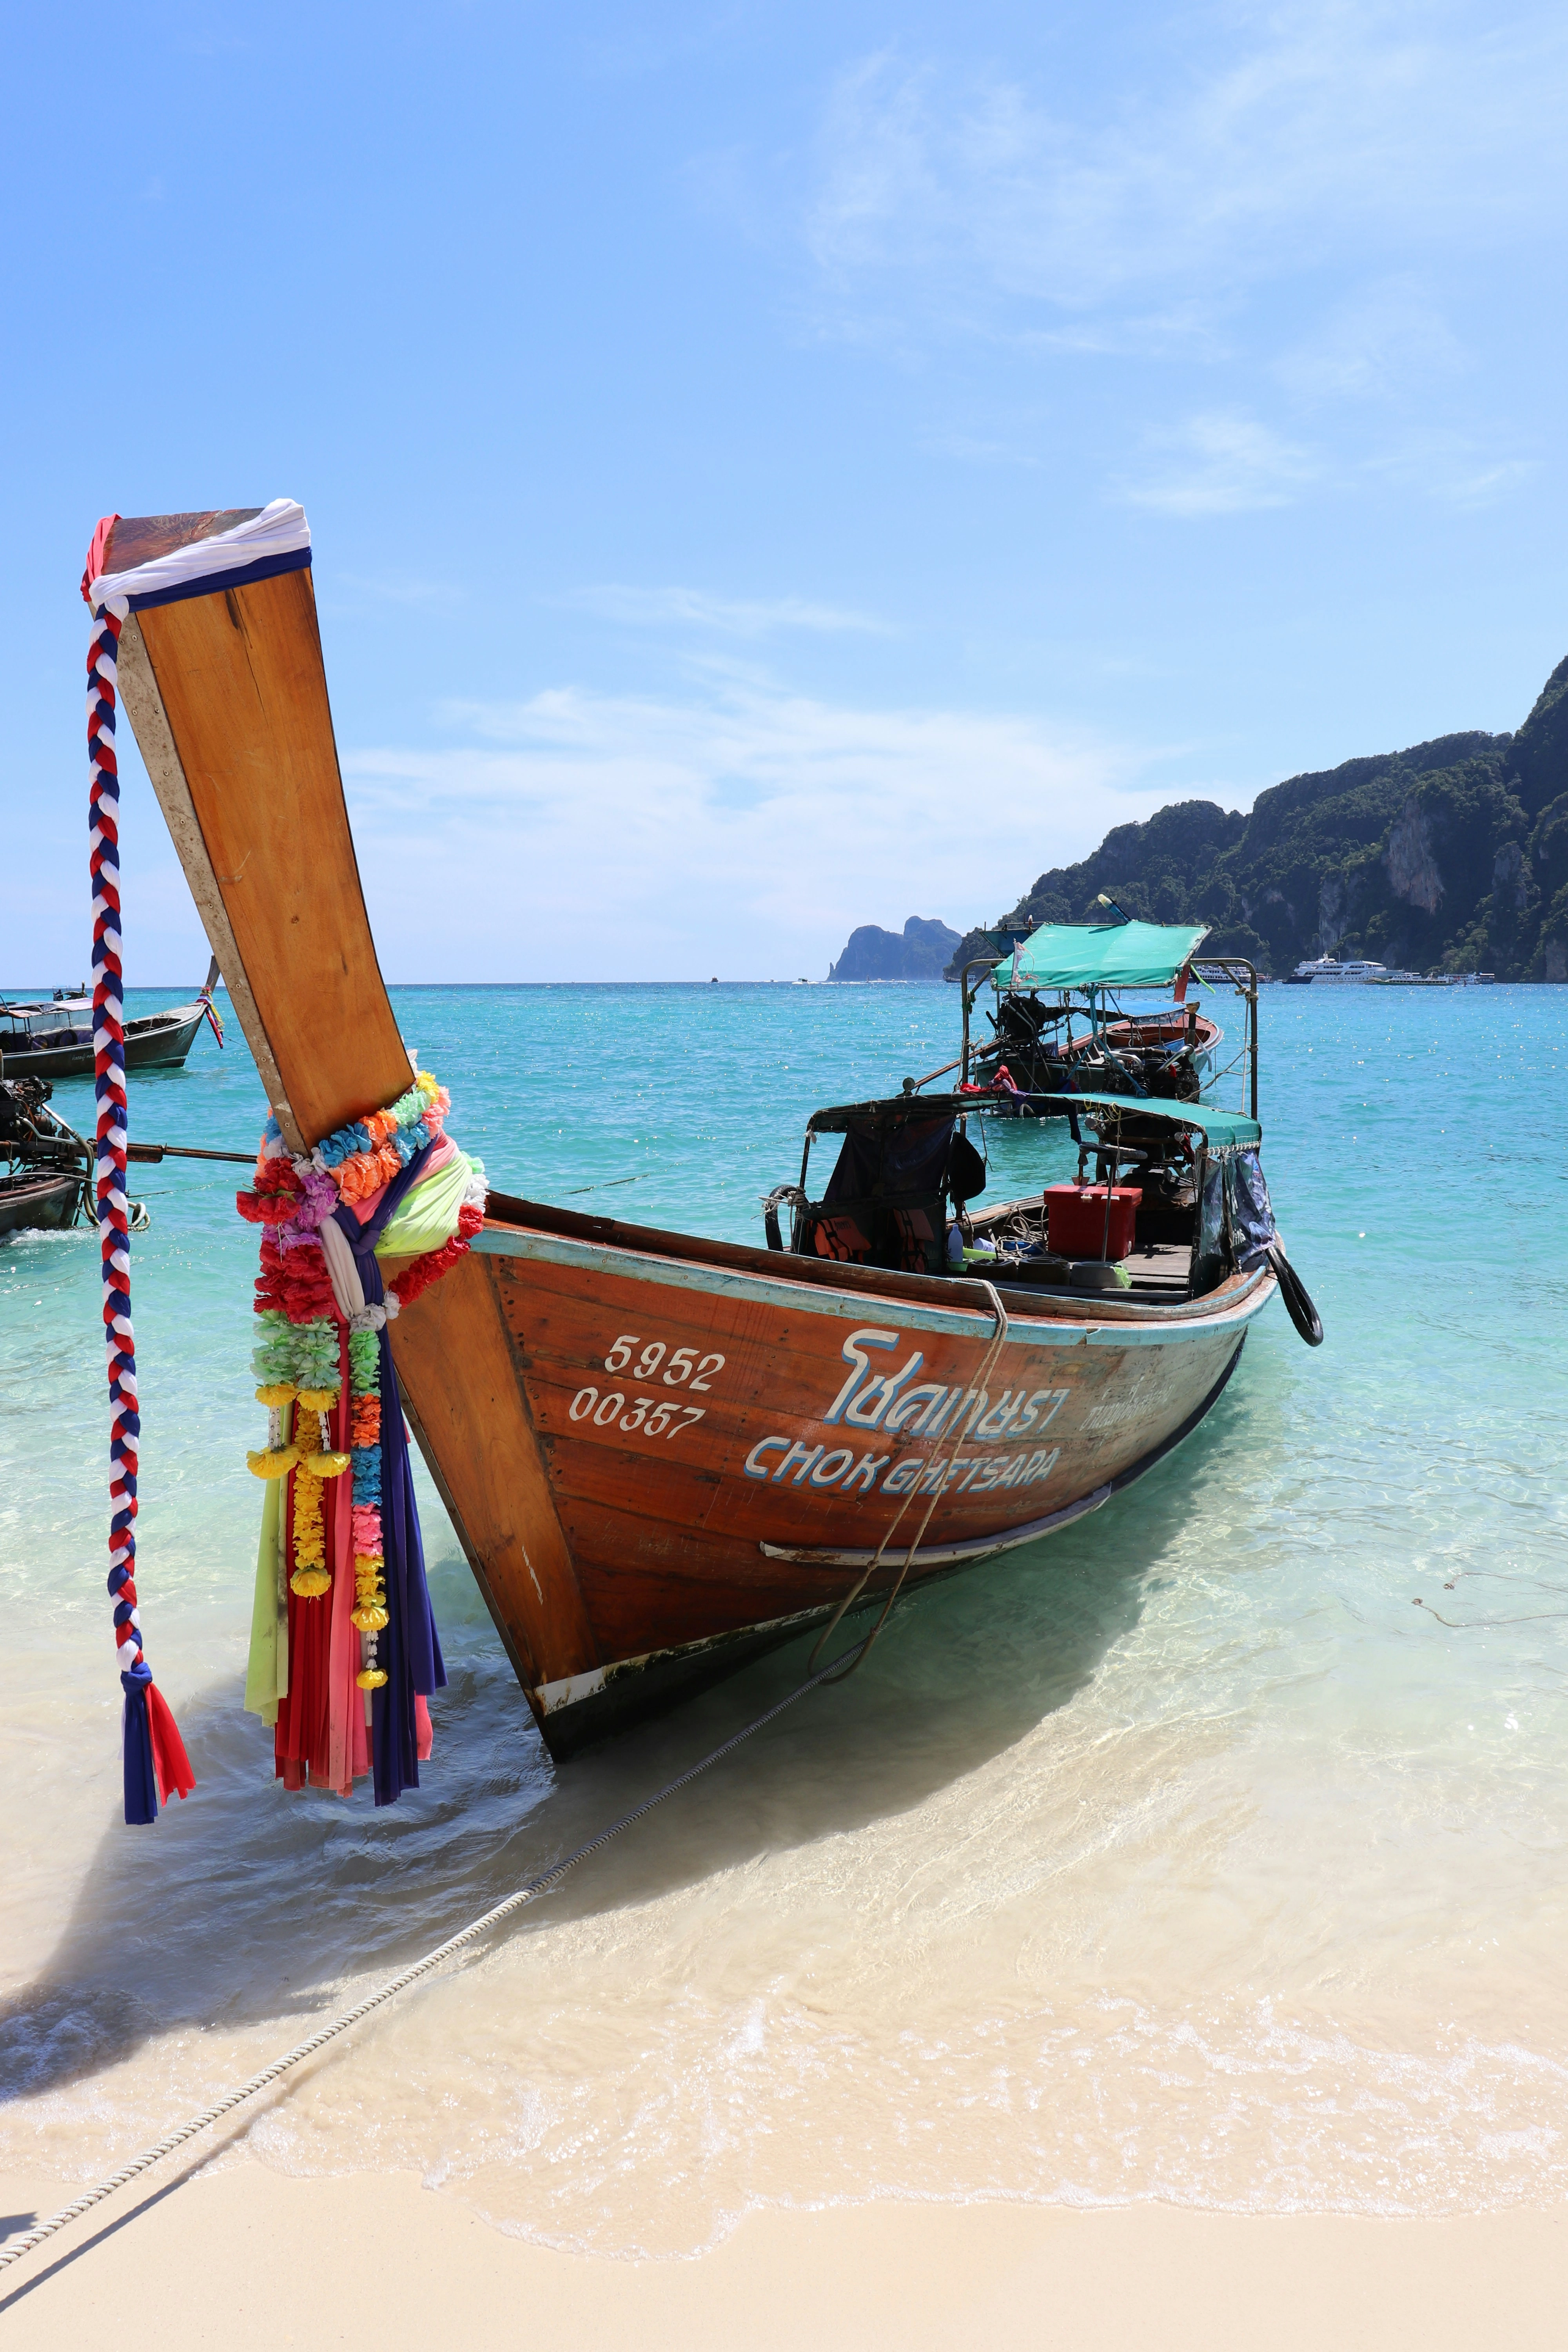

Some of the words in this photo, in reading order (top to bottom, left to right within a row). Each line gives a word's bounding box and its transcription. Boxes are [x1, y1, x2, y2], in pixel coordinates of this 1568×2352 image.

[604, 1335, 725, 1390] 5952
[569, 1387, 706, 1439] 00357
[744, 1436, 891, 1494] CHOK
[879, 1447, 1061, 1495] GHETSARA
